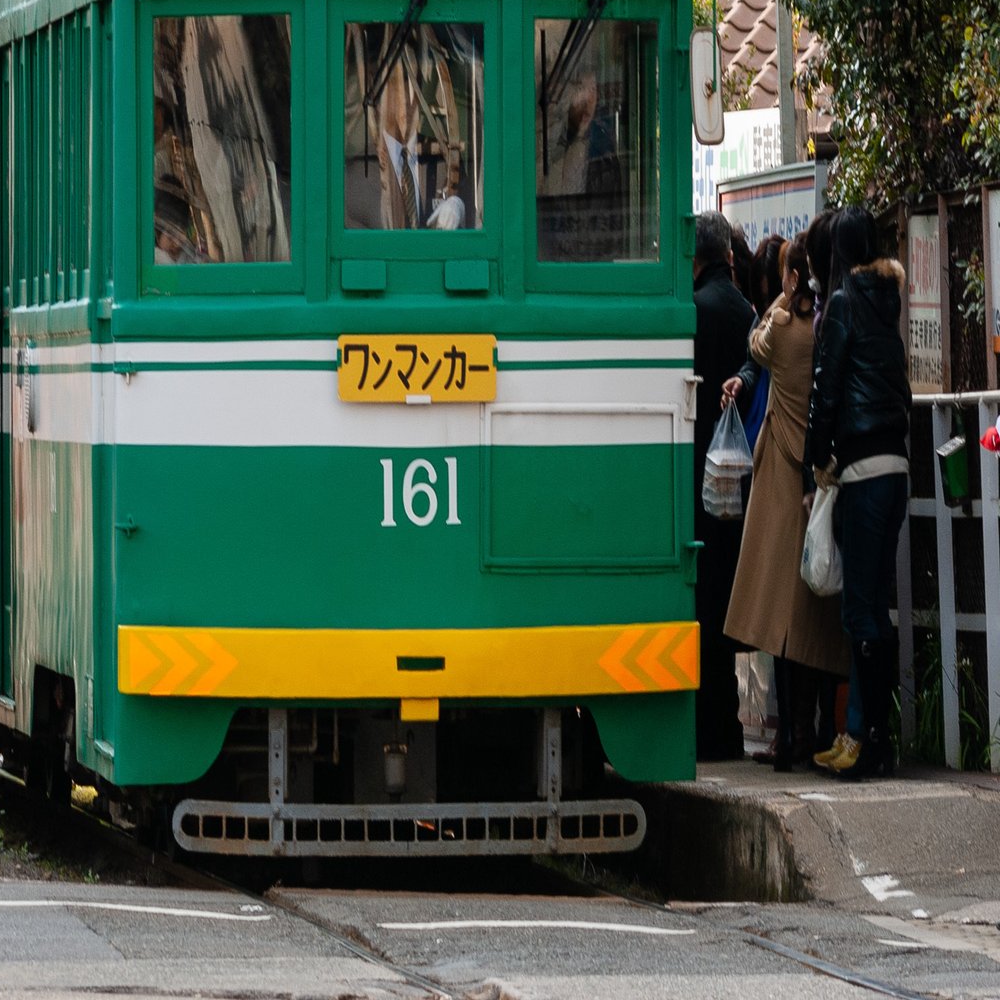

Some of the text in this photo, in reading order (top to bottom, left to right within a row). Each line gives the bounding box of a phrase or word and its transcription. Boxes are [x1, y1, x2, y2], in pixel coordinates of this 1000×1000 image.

[343, 344, 490, 390] ワンマンカー
[379, 457, 462, 527] 161
